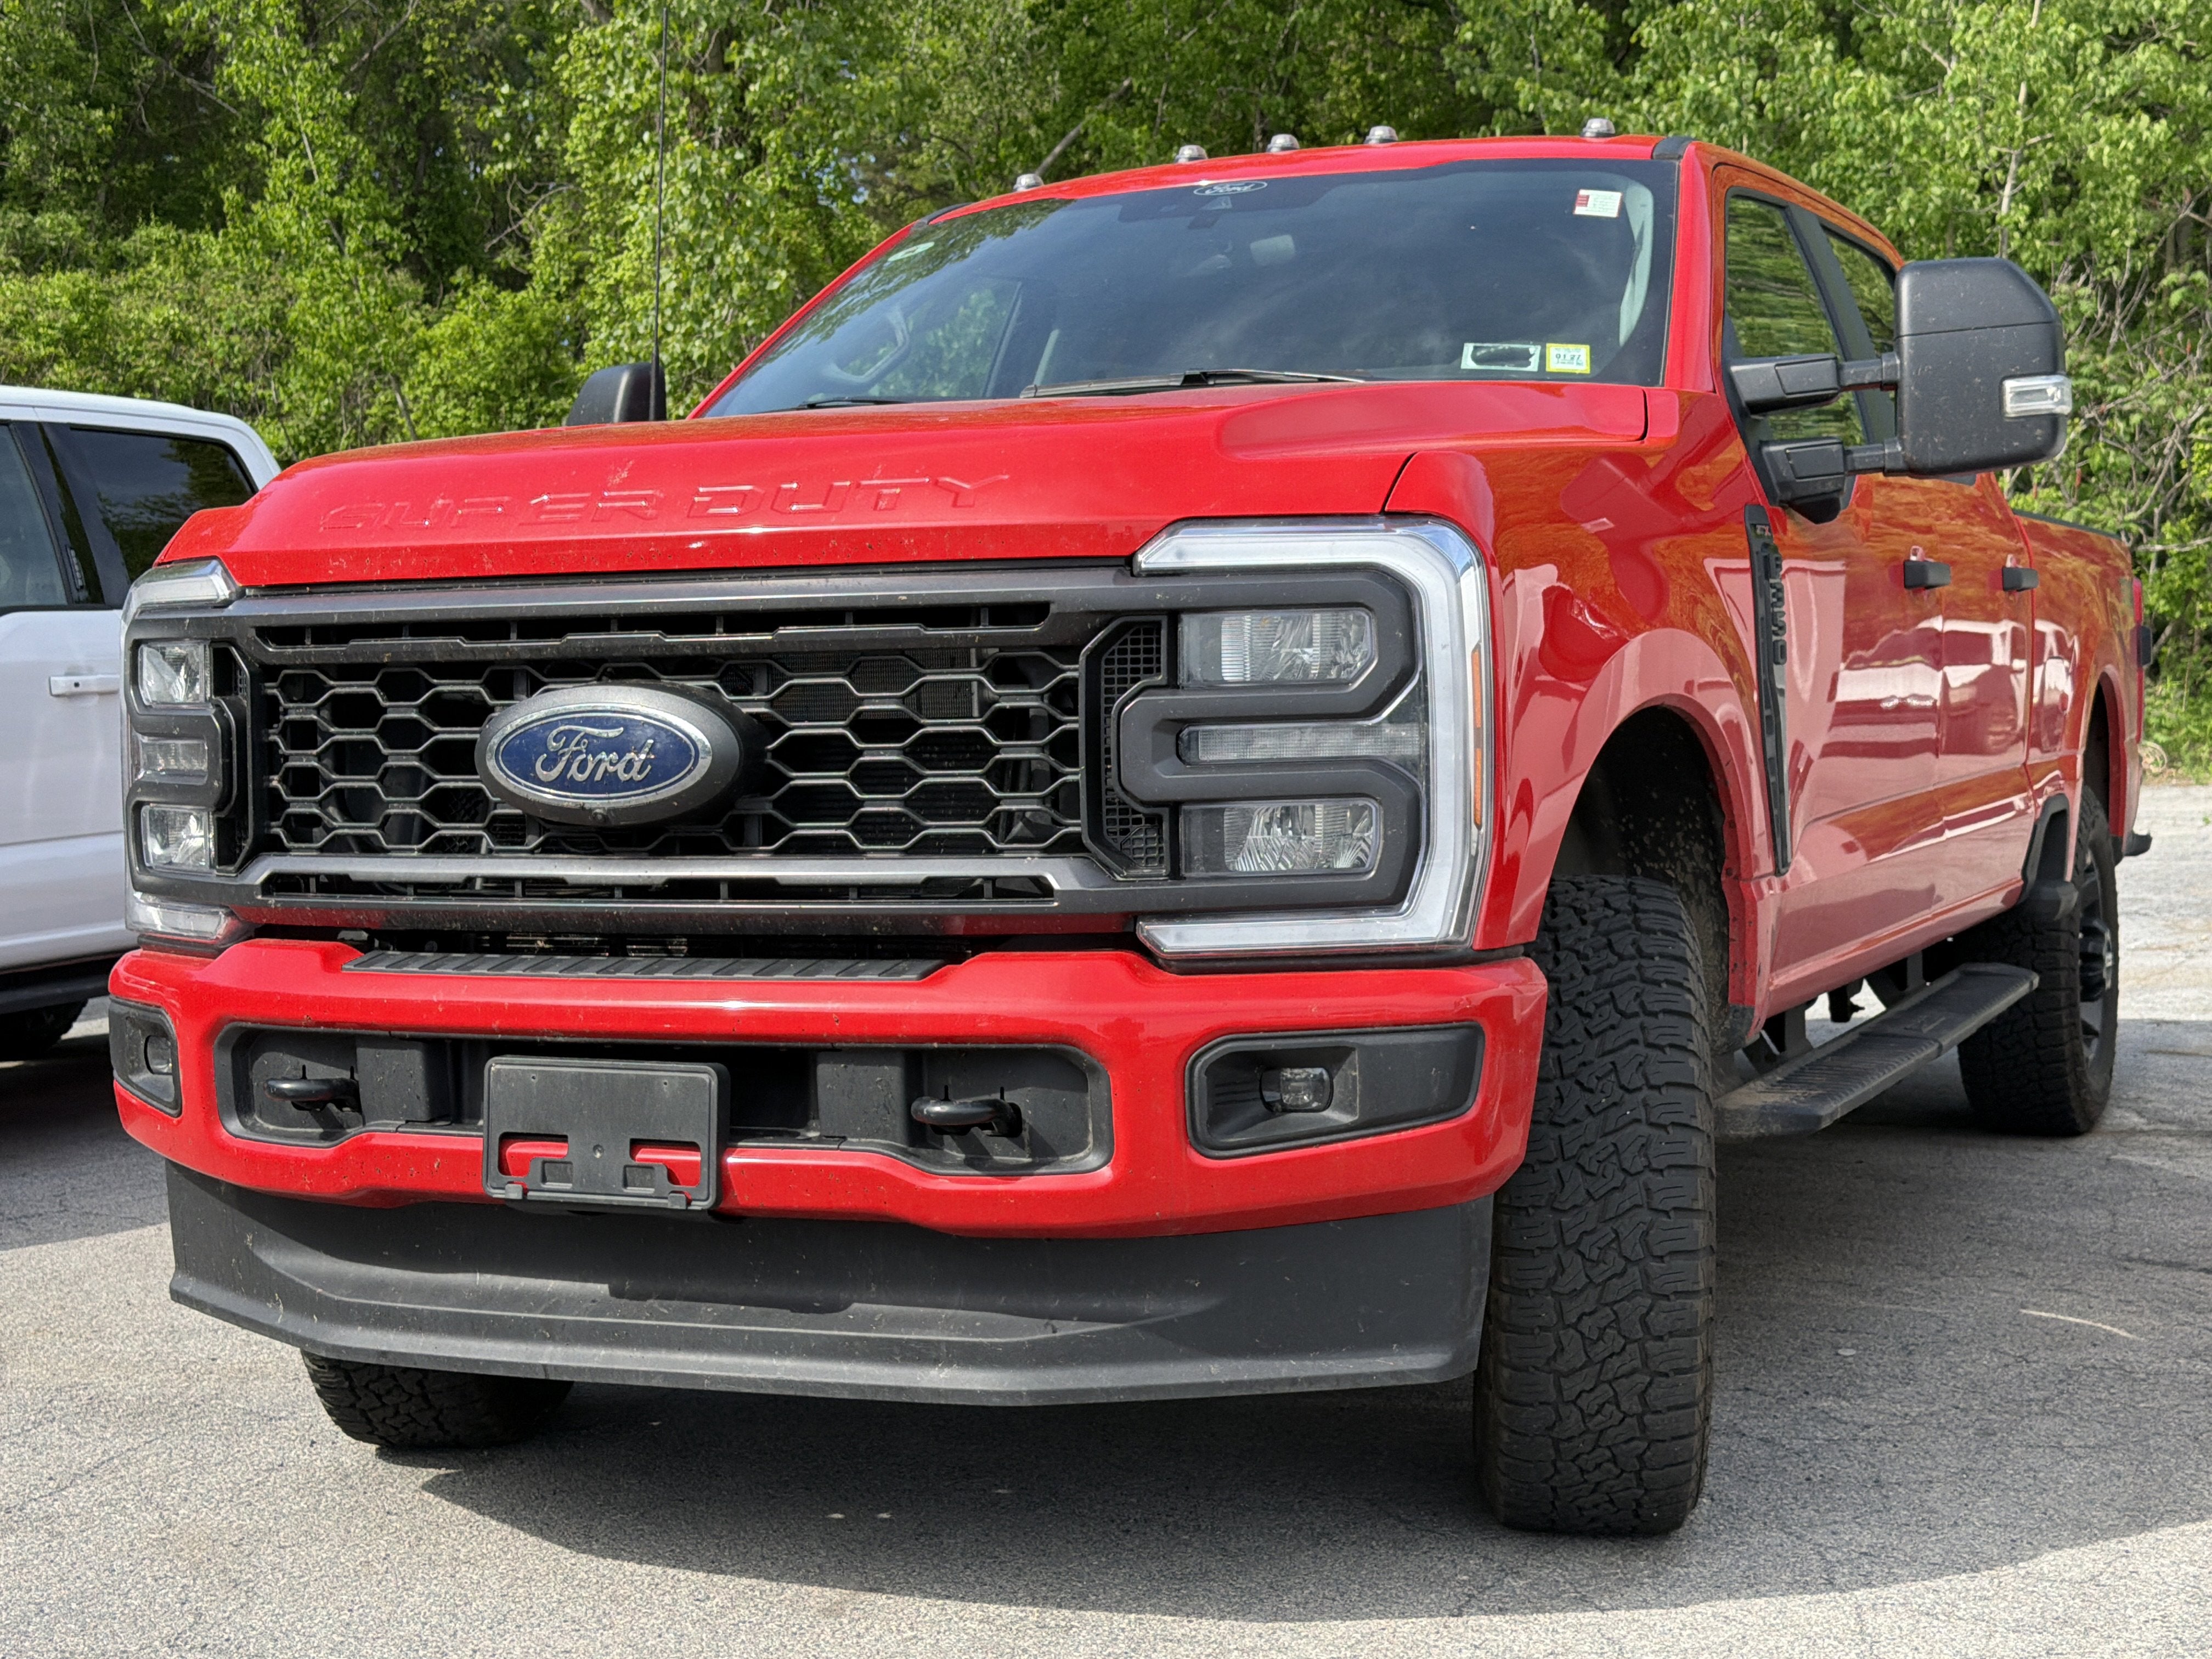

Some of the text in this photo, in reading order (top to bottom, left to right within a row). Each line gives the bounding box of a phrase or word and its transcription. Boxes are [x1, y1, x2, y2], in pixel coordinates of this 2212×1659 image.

[1205, 183, 1255, 194] Ford
[319, 474, 1011, 532] SUPER DUTY
[535, 725, 656, 782] Ford
